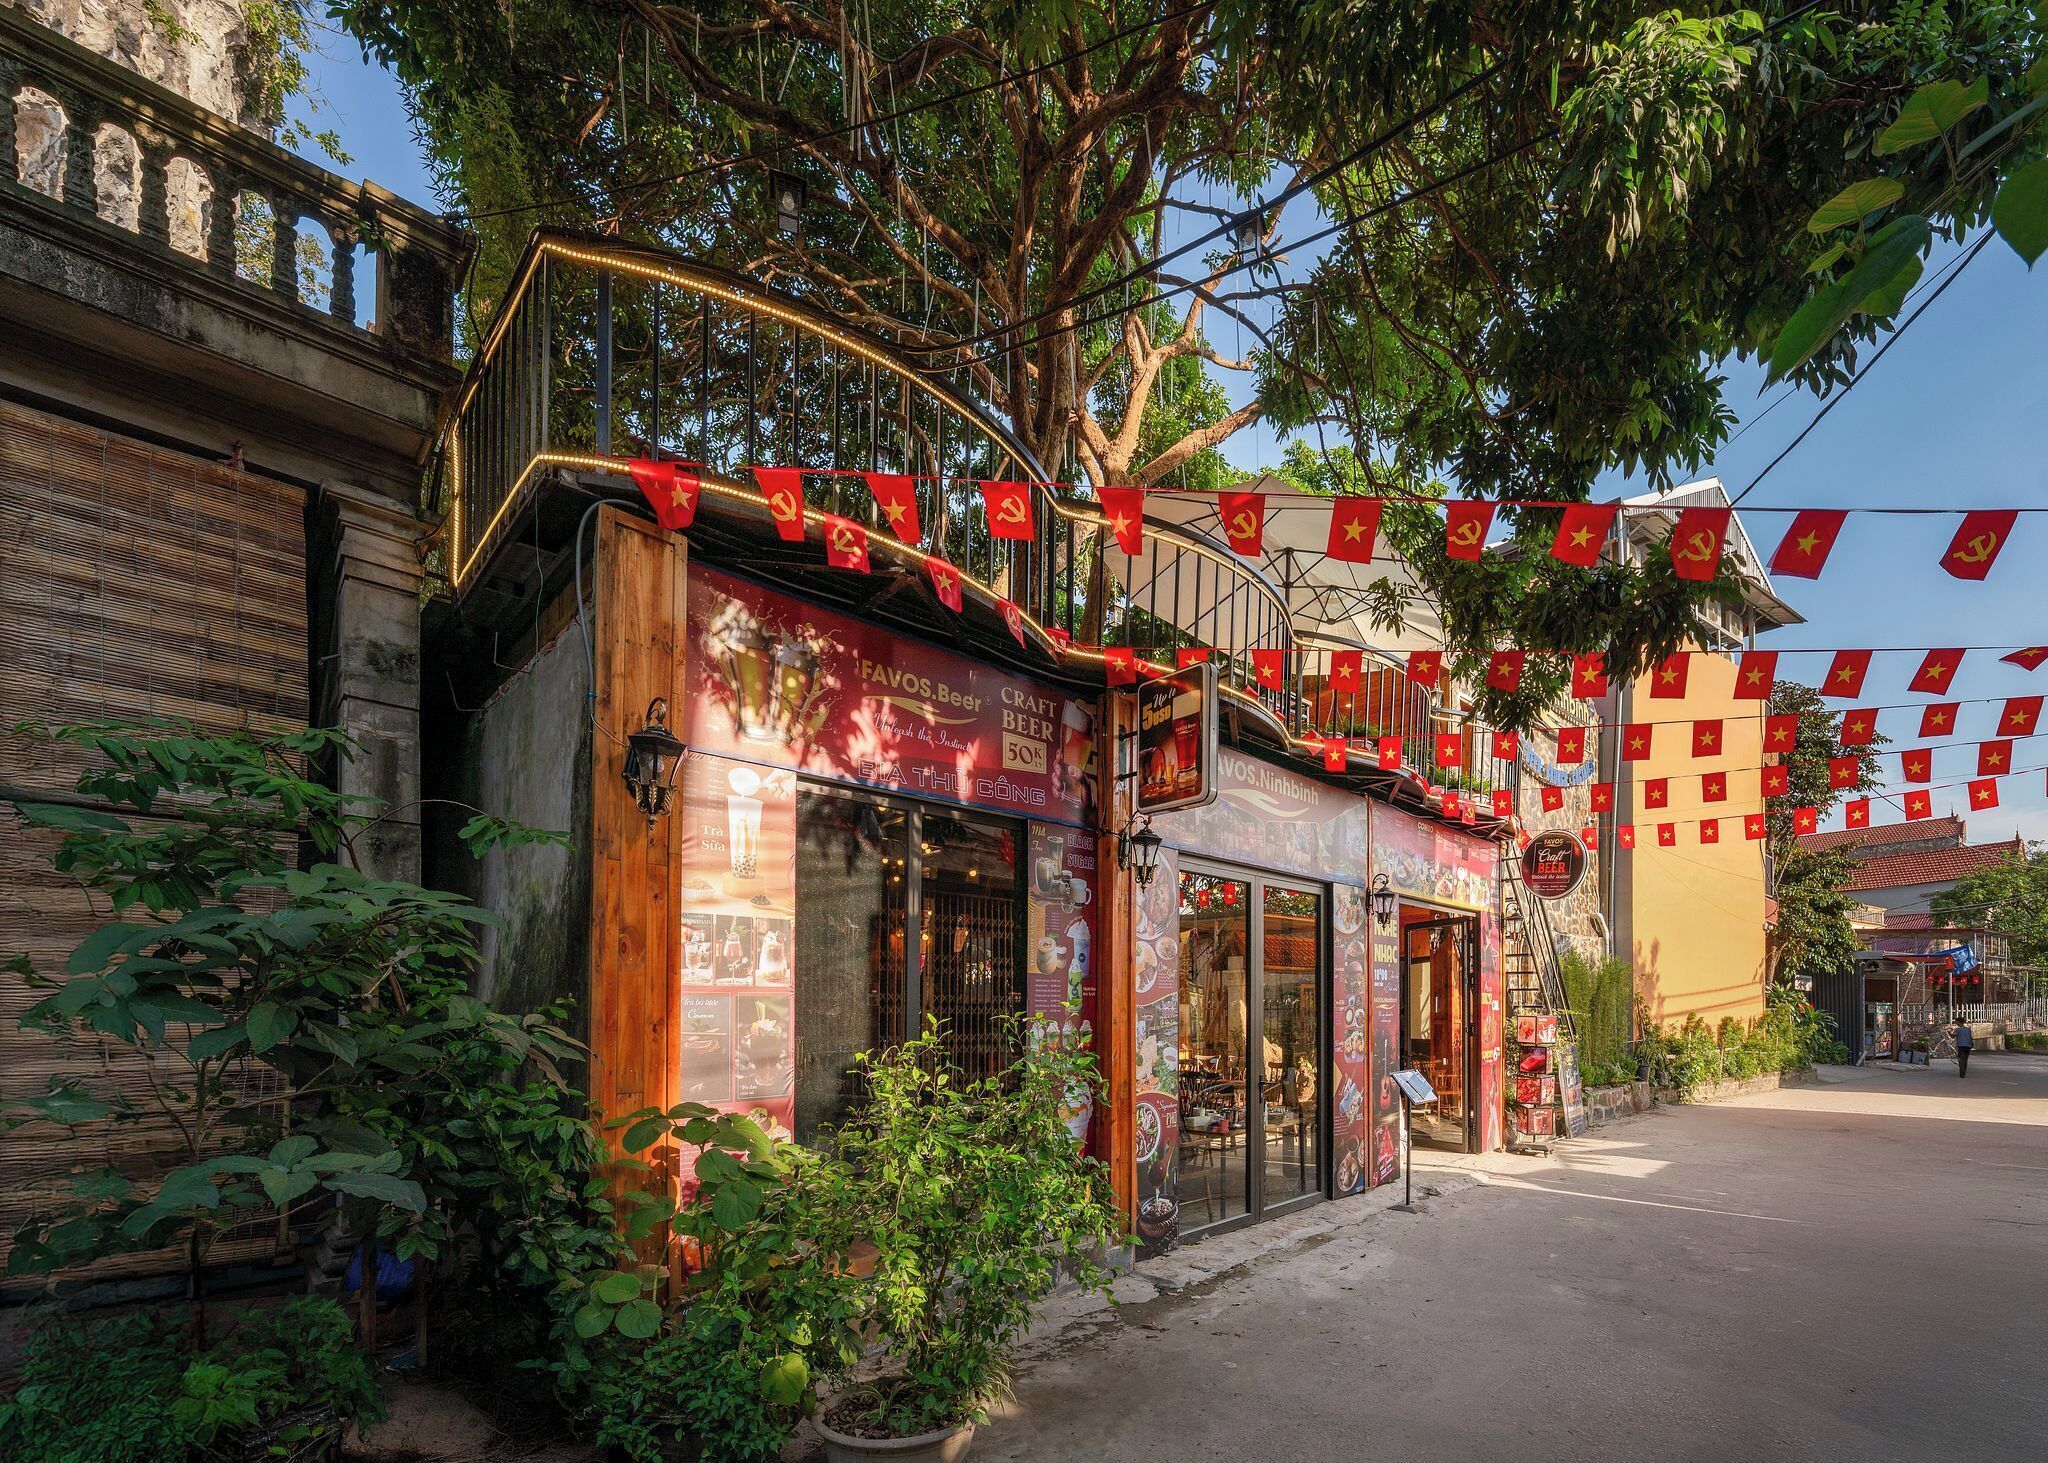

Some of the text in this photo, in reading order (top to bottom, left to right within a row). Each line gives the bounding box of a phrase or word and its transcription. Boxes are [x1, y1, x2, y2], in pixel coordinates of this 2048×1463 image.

[861, 659, 982, 712] FAVOS.Beer
[1001, 687, 1057, 718] CRAFT
[874, 712, 972, 752] Unleash the Instinct
[1002, 708, 1054, 743] BEER
[1007, 741, 1043, 765] 50K
[857, 758, 1045, 806] BIA THỦ CÔNG
[1218, 752, 1319, 806] AVOS.Ninhbinh
[701, 824, 724, 836] Trà
[701, 839, 725, 851] Sữa
[1538, 848, 1571, 863] Craft
[1537, 861, 1566, 874] BEER
[1374, 943, 1398, 967] NHẠC
